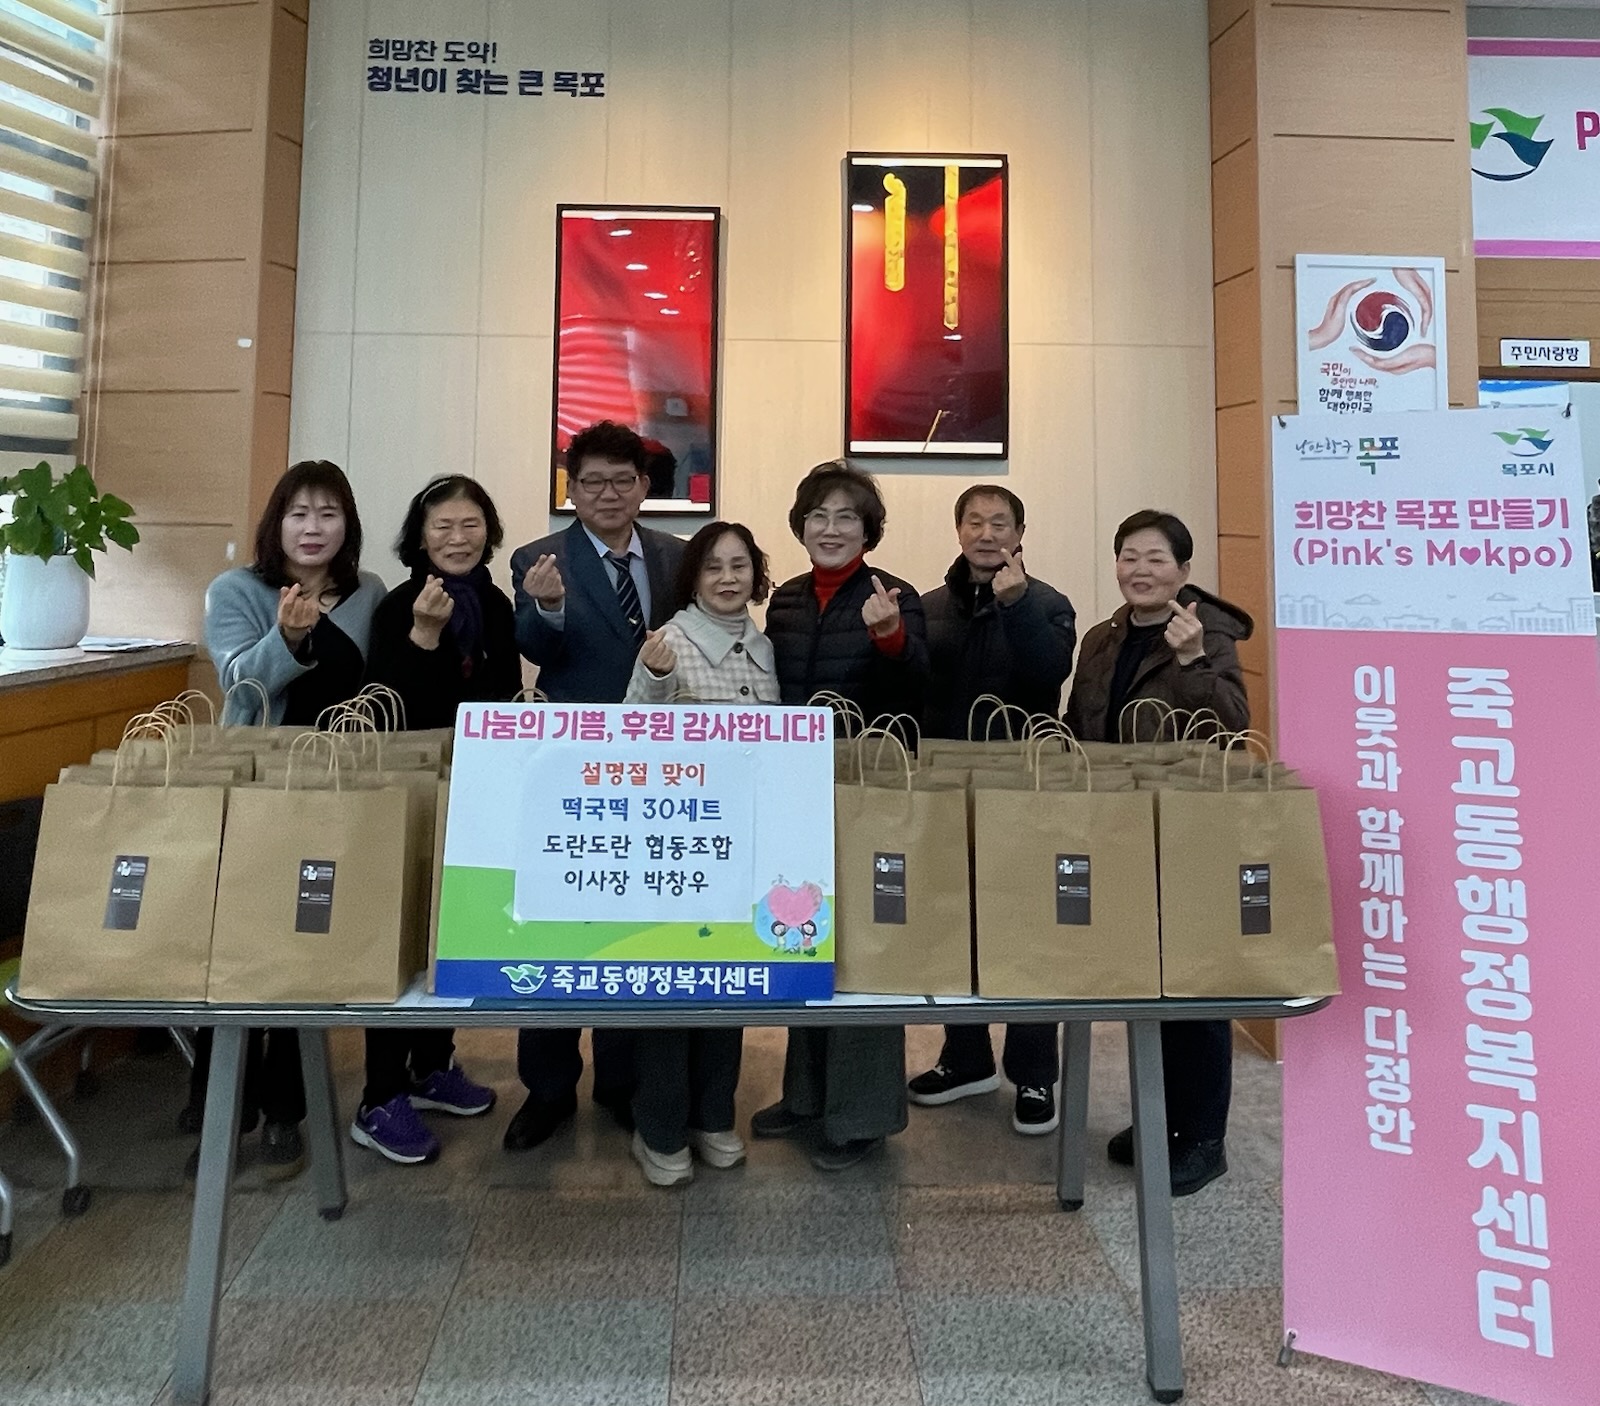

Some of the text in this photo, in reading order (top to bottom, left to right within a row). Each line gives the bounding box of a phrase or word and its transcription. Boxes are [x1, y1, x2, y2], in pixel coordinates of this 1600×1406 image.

[368, 38, 498, 63] 희망찬 도약!
[366, 65, 605, 98] 청년이 찾는 큰 목포
[1511, 345, 1579, 362] 주민사랑방
[1320, 362, 1351, 376] 국민이
[1319, 388, 1343, 402] 함께
[1327, 401, 1373, 414] 대한민국
[1356, 436, 1401, 475] 목포
[1501, 462, 1555, 476] 목포시
[1294, 498, 1570, 531] 희망찬 목포 만들기
[1293, 538, 1413, 567] (Pink's
[464, 711, 825, 743] 나눔의 기쁨, 후원 감사합니다!
[580, 762, 706, 787] 설명절 맞이
[562, 797, 722, 822] 떡국떡 30세트
[542, 834, 733, 860] 도란도란 협동조합
[564, 870, 710, 896] 이사장 박창우
[1353, 664, 1415, 1156] 이웃과 함께하는 다정한
[550, 966, 770, 995] 죽교동행정복지센터
[1446, 665, 1554, 1358] 죽교동행정복지센터
